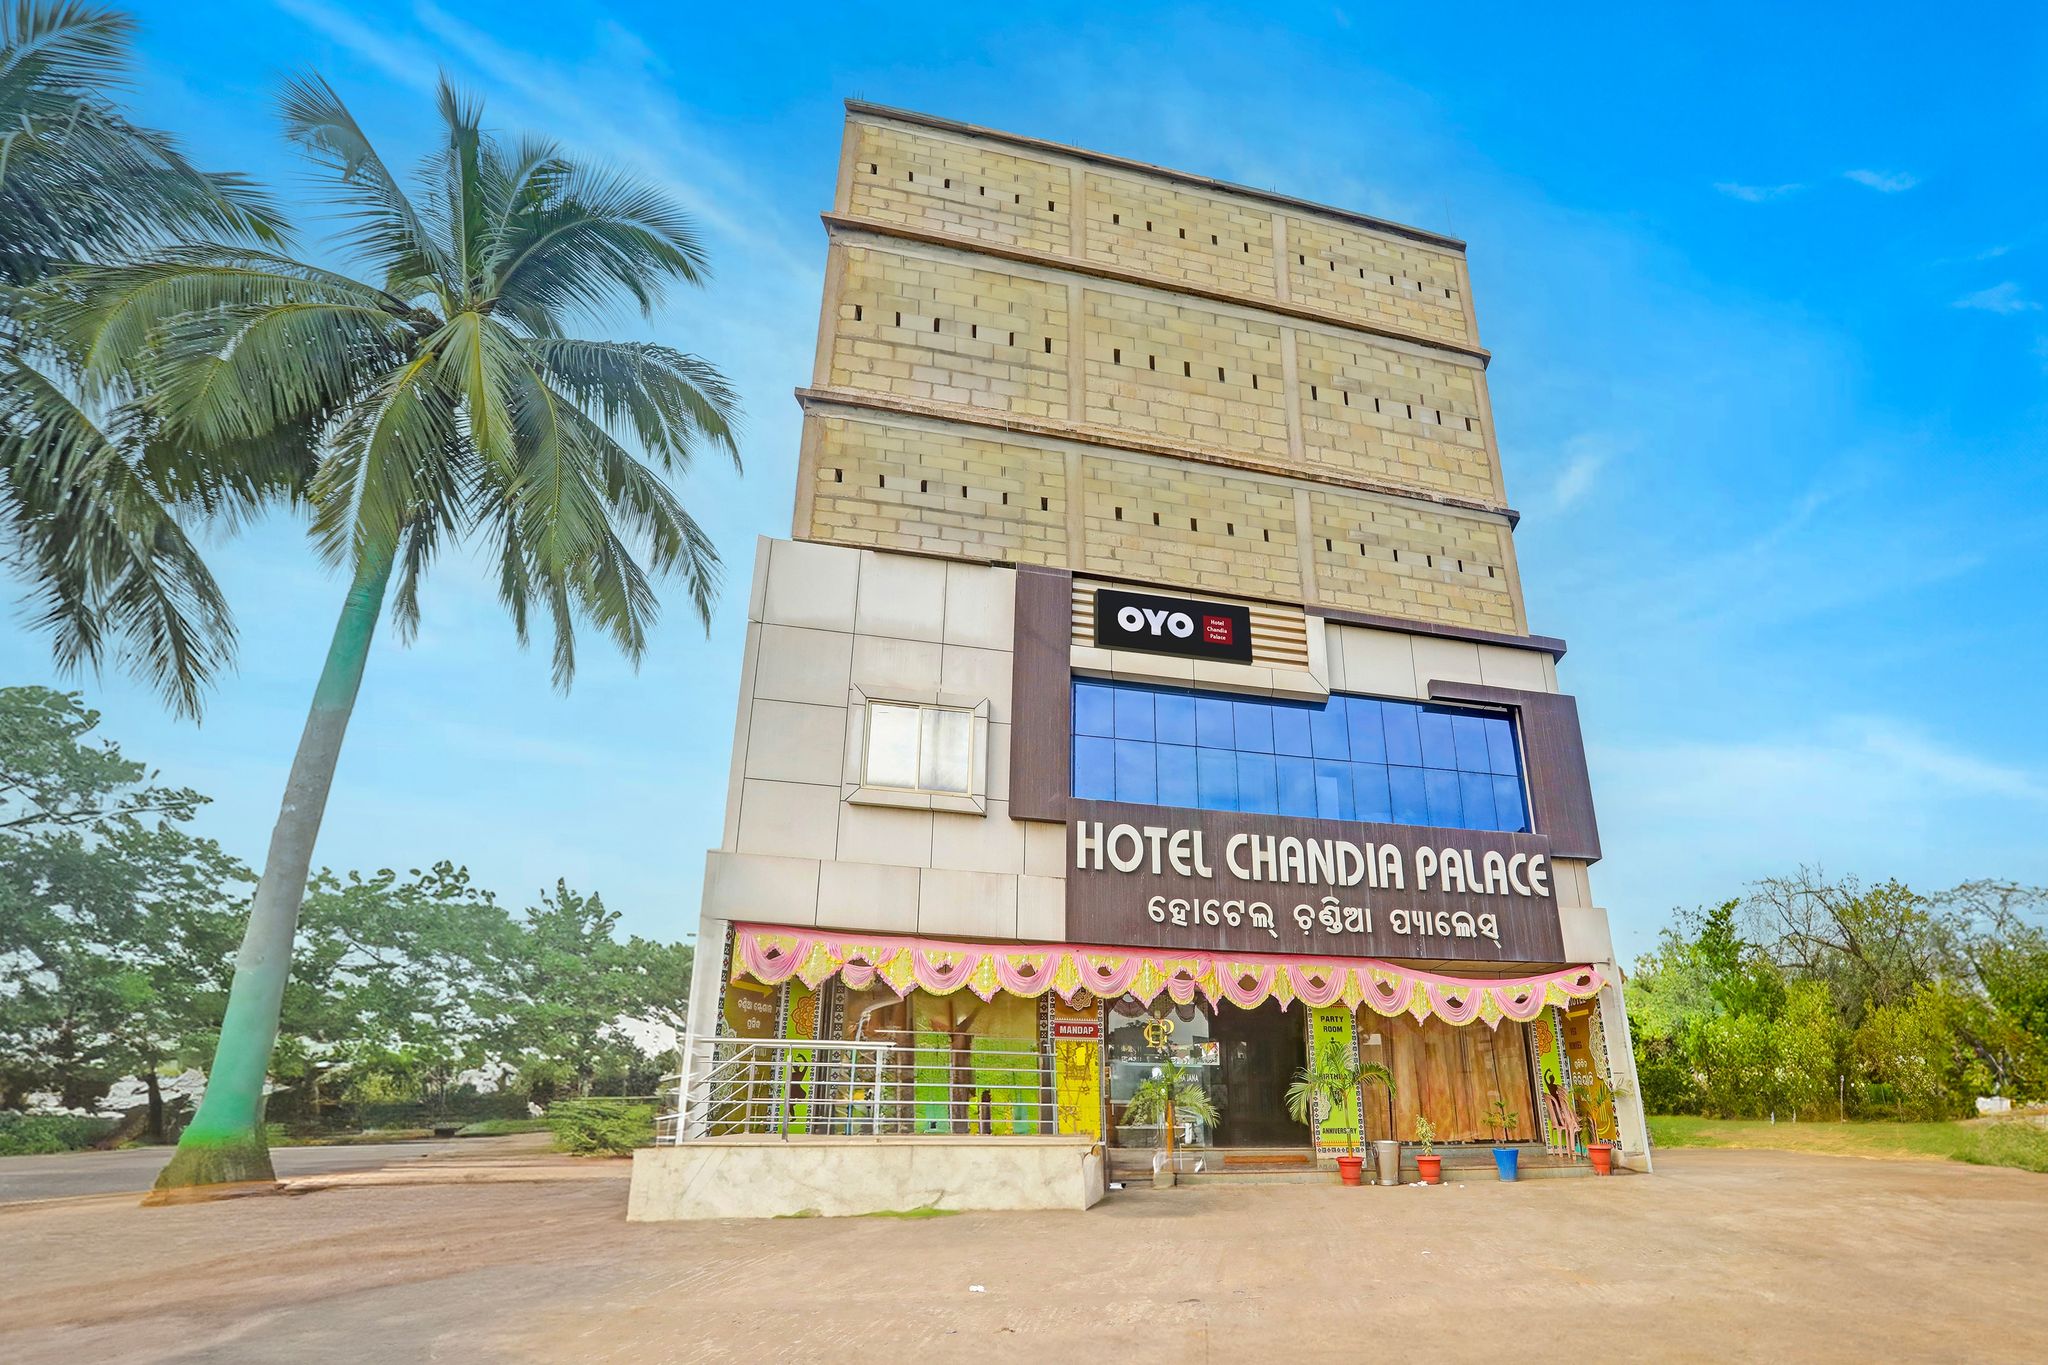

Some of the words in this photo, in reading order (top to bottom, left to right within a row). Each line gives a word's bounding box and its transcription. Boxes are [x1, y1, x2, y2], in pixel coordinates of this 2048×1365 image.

[1117, 606, 1194, 638] OYO
[1206, 626, 1228, 634] Chandia
[1210, 633, 1227, 641] Palace
[1076, 820, 1212, 878] HOTEL
[1226, 833, 1405, 889] CHANDIA
[1415, 846, 1550, 897] PALACE
[1059, 1025, 1094, 1035] MANDAP
